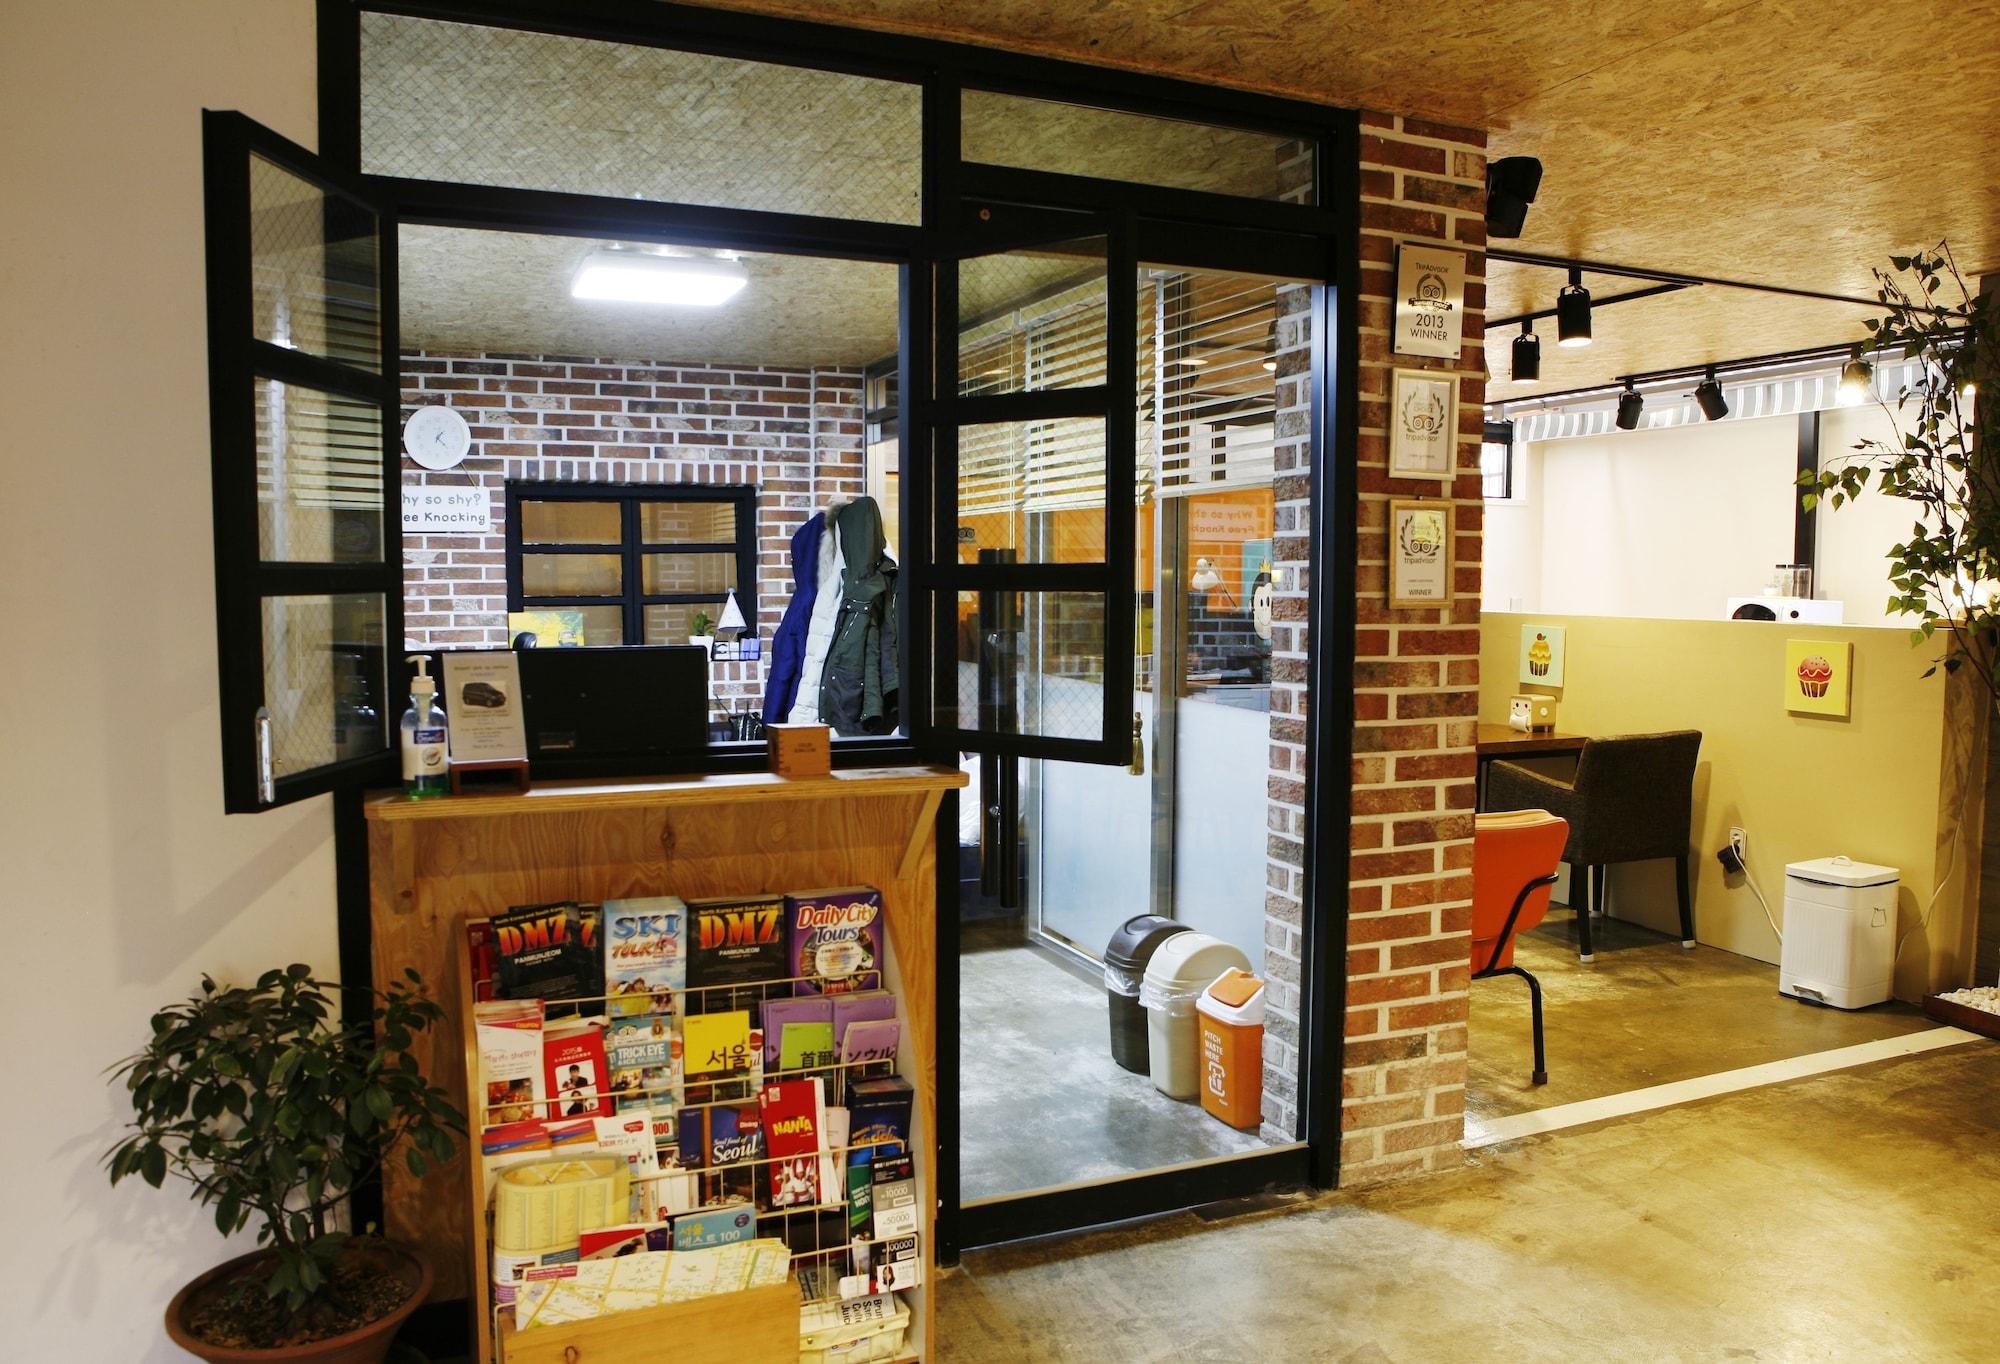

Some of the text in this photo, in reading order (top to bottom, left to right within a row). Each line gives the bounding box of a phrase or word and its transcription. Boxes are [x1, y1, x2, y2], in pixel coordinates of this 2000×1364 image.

[1416, 313, 1444, 328] 2013
[1410, 328, 1448, 341] WINNER
[402, 493, 481, 507] hy so shy?
[403, 512, 486, 525] ee Knocking
[798, 902, 878, 928] Daily City
[496, 914, 571, 957] DMZ
[613, 914, 681, 940] SKI
[698, 909, 780, 951] DMZ
[816, 925, 859, 944] Tours
[1204, 1029, 1221, 1045] PITCH
[617, 1045, 646, 1060] TRICK
[646, 1043, 665, 1057] EYE
[848, 1046, 895, 1063] ソウル
[1204, 1040, 1224, 1056] WASTE
[706, 1044, 750, 1070] 서울
[772, 1116, 813, 1136] NANTA
[712, 1135, 759, 1164] Seoul
[720, 1229, 740, 1243] 100
